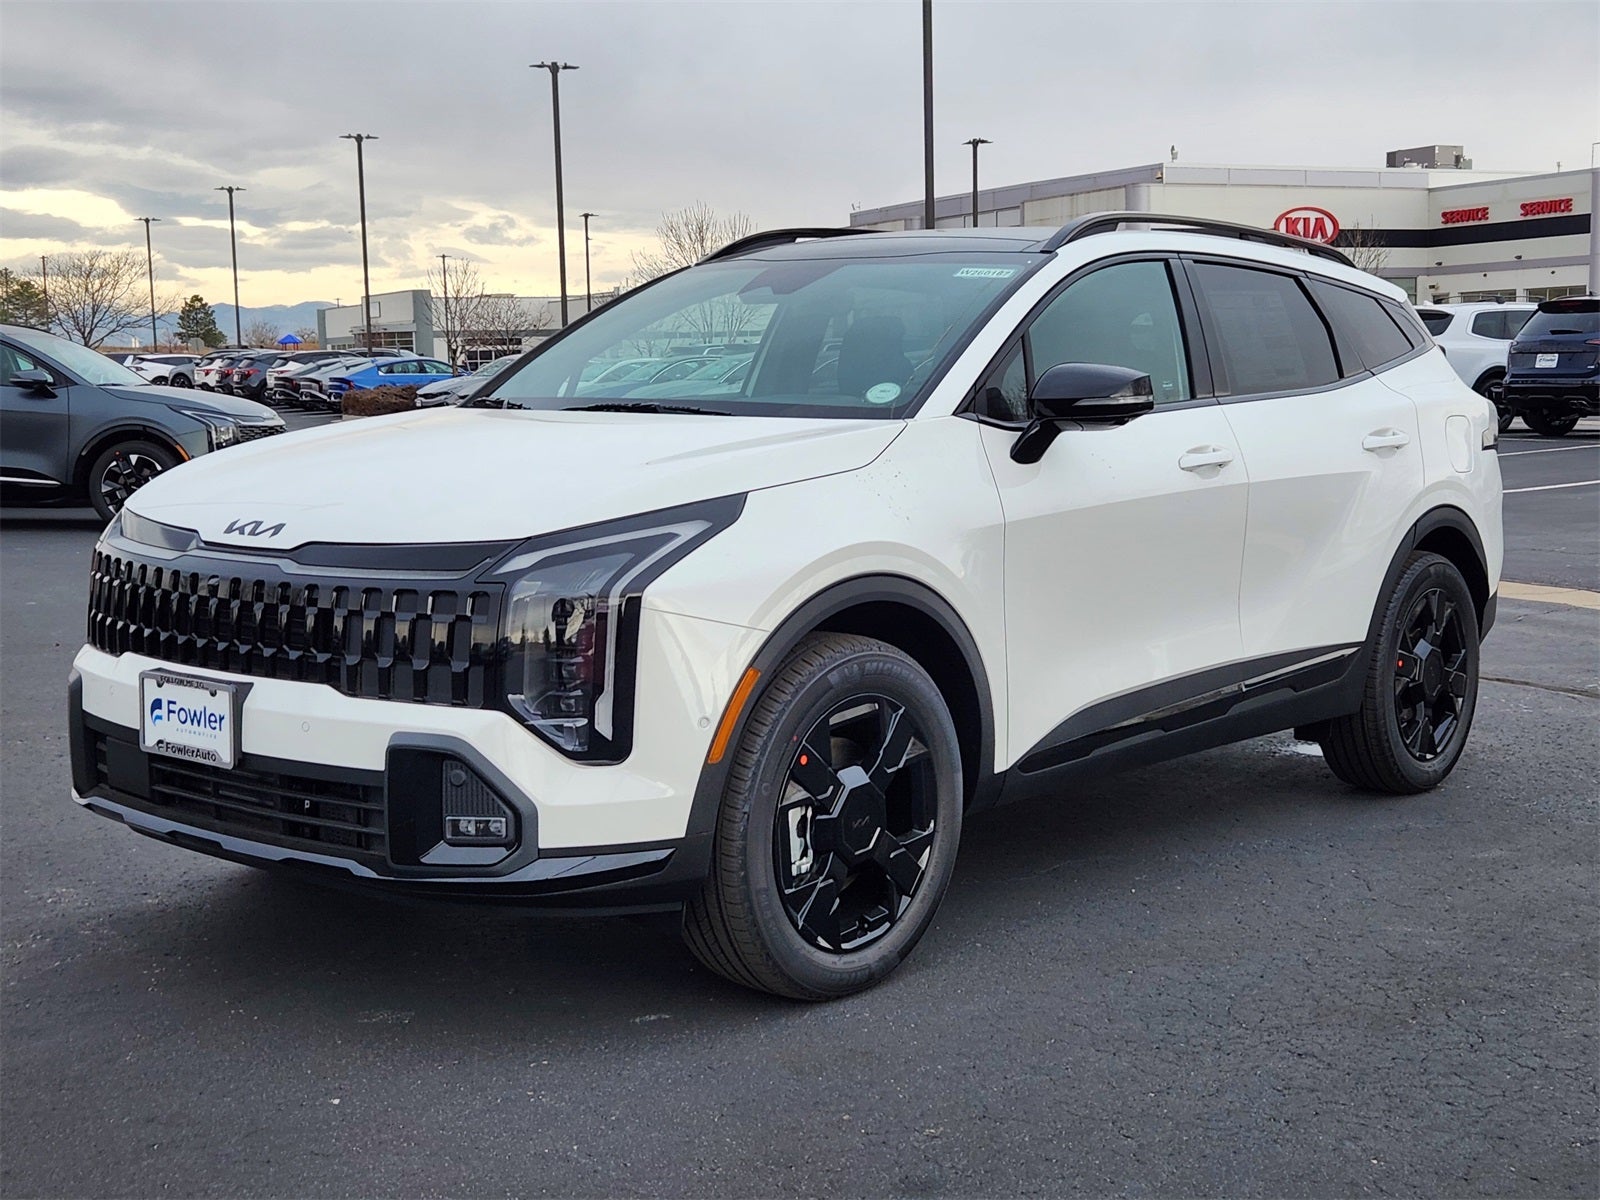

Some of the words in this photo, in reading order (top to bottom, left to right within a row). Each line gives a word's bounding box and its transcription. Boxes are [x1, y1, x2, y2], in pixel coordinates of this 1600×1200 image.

[1441, 207, 1489, 224] SERVICE
[1520, 198, 1573, 217] SERVICE
[1285, 217, 1328, 239] KIA
[167, 699, 225, 732] Fowler
[165, 742, 217, 762] FowlerAuto
